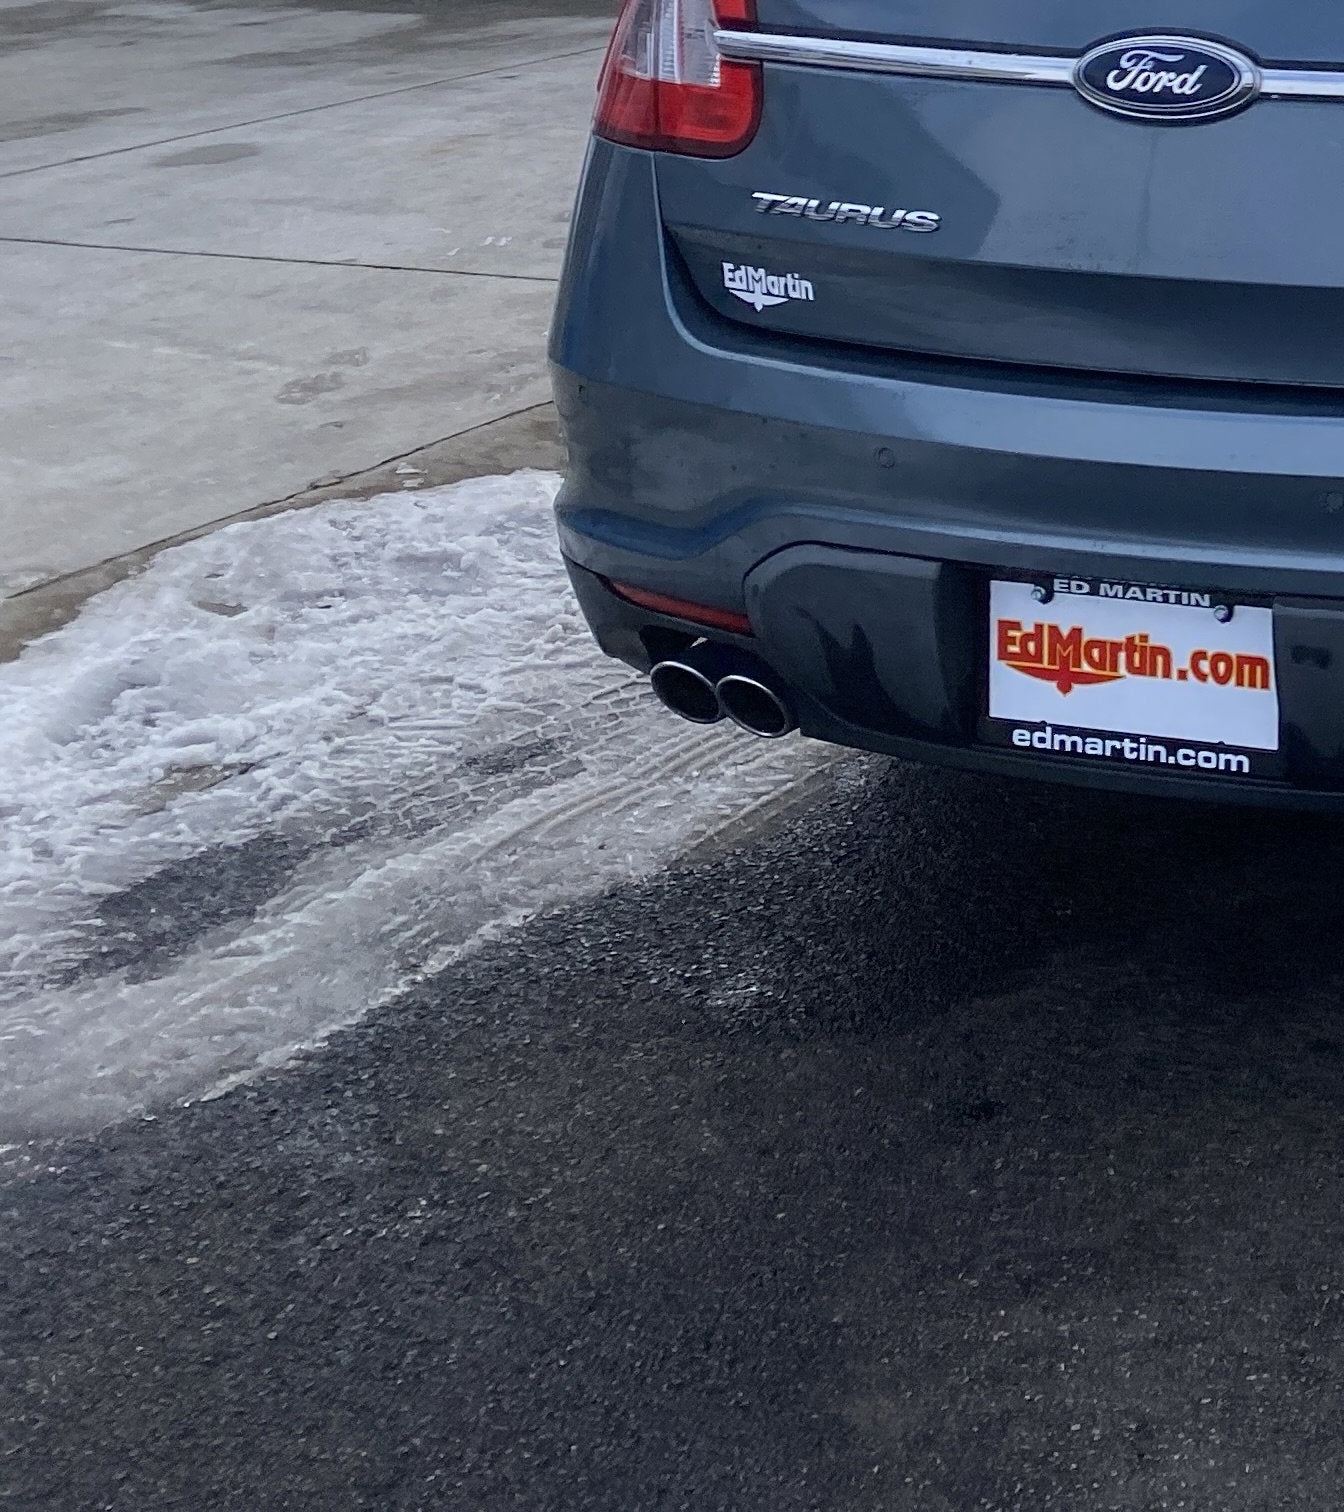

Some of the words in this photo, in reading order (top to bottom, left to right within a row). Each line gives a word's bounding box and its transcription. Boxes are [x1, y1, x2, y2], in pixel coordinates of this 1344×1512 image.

[1106, 49, 1209, 95] Ford
[751, 191, 941, 232] TAURUS
[721, 261, 815, 301] EdMartin
[1053, 578, 1091, 595] ED
[1099, 583, 1212, 608] MARTIN
[996, 619, 1271, 691] EdMartin.com
[1011, 726, 1250, 774] edmartin.com
